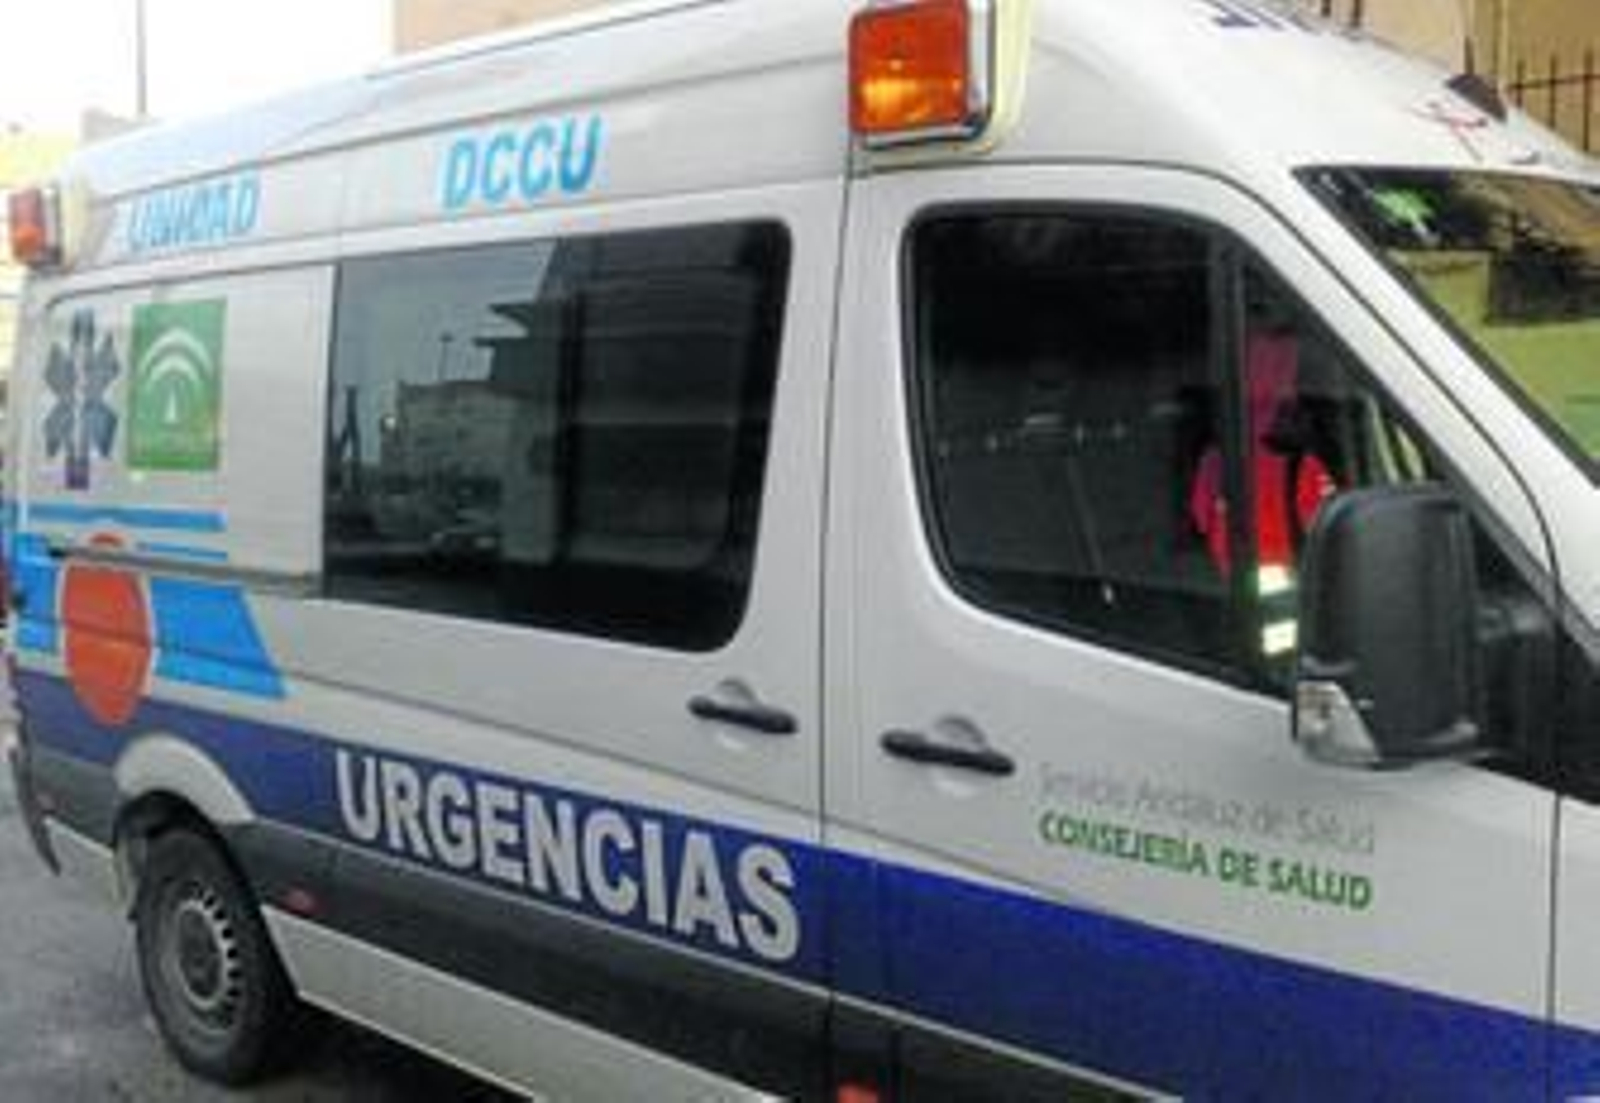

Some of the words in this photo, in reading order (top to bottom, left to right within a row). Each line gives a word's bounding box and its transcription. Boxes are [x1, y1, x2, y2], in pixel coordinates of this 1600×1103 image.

[441, 115, 603, 210] DCCU
[335, 750, 800, 962] URGENCIAS
[1219, 847, 1260, 888] DE
[1267, 857, 1373, 911] SALUD
